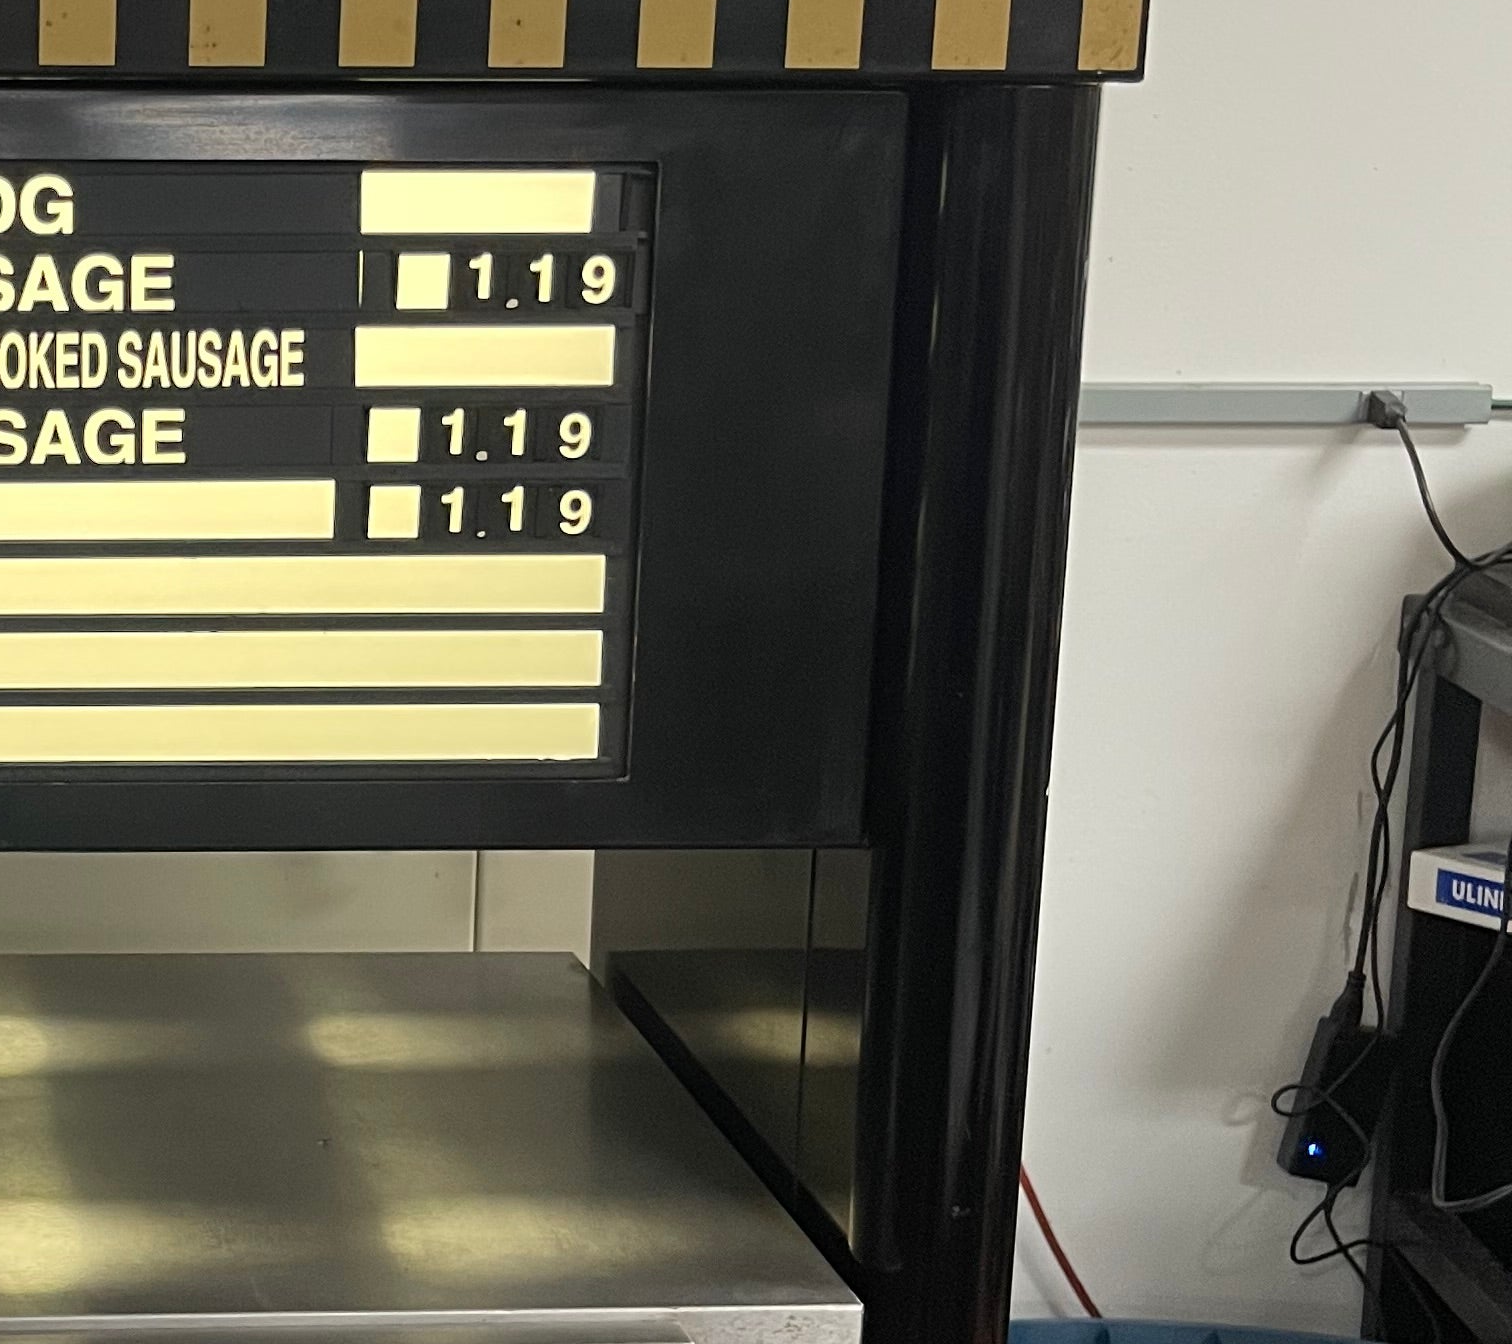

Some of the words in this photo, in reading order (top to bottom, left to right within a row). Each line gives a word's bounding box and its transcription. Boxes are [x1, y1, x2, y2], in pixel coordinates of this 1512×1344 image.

[468, 251, 617, 309] 1.19
[117, 327, 306, 389] SAUSAGE
[441, 407, 592, 461] 1.19
[440, 485, 593, 538] 1.19
